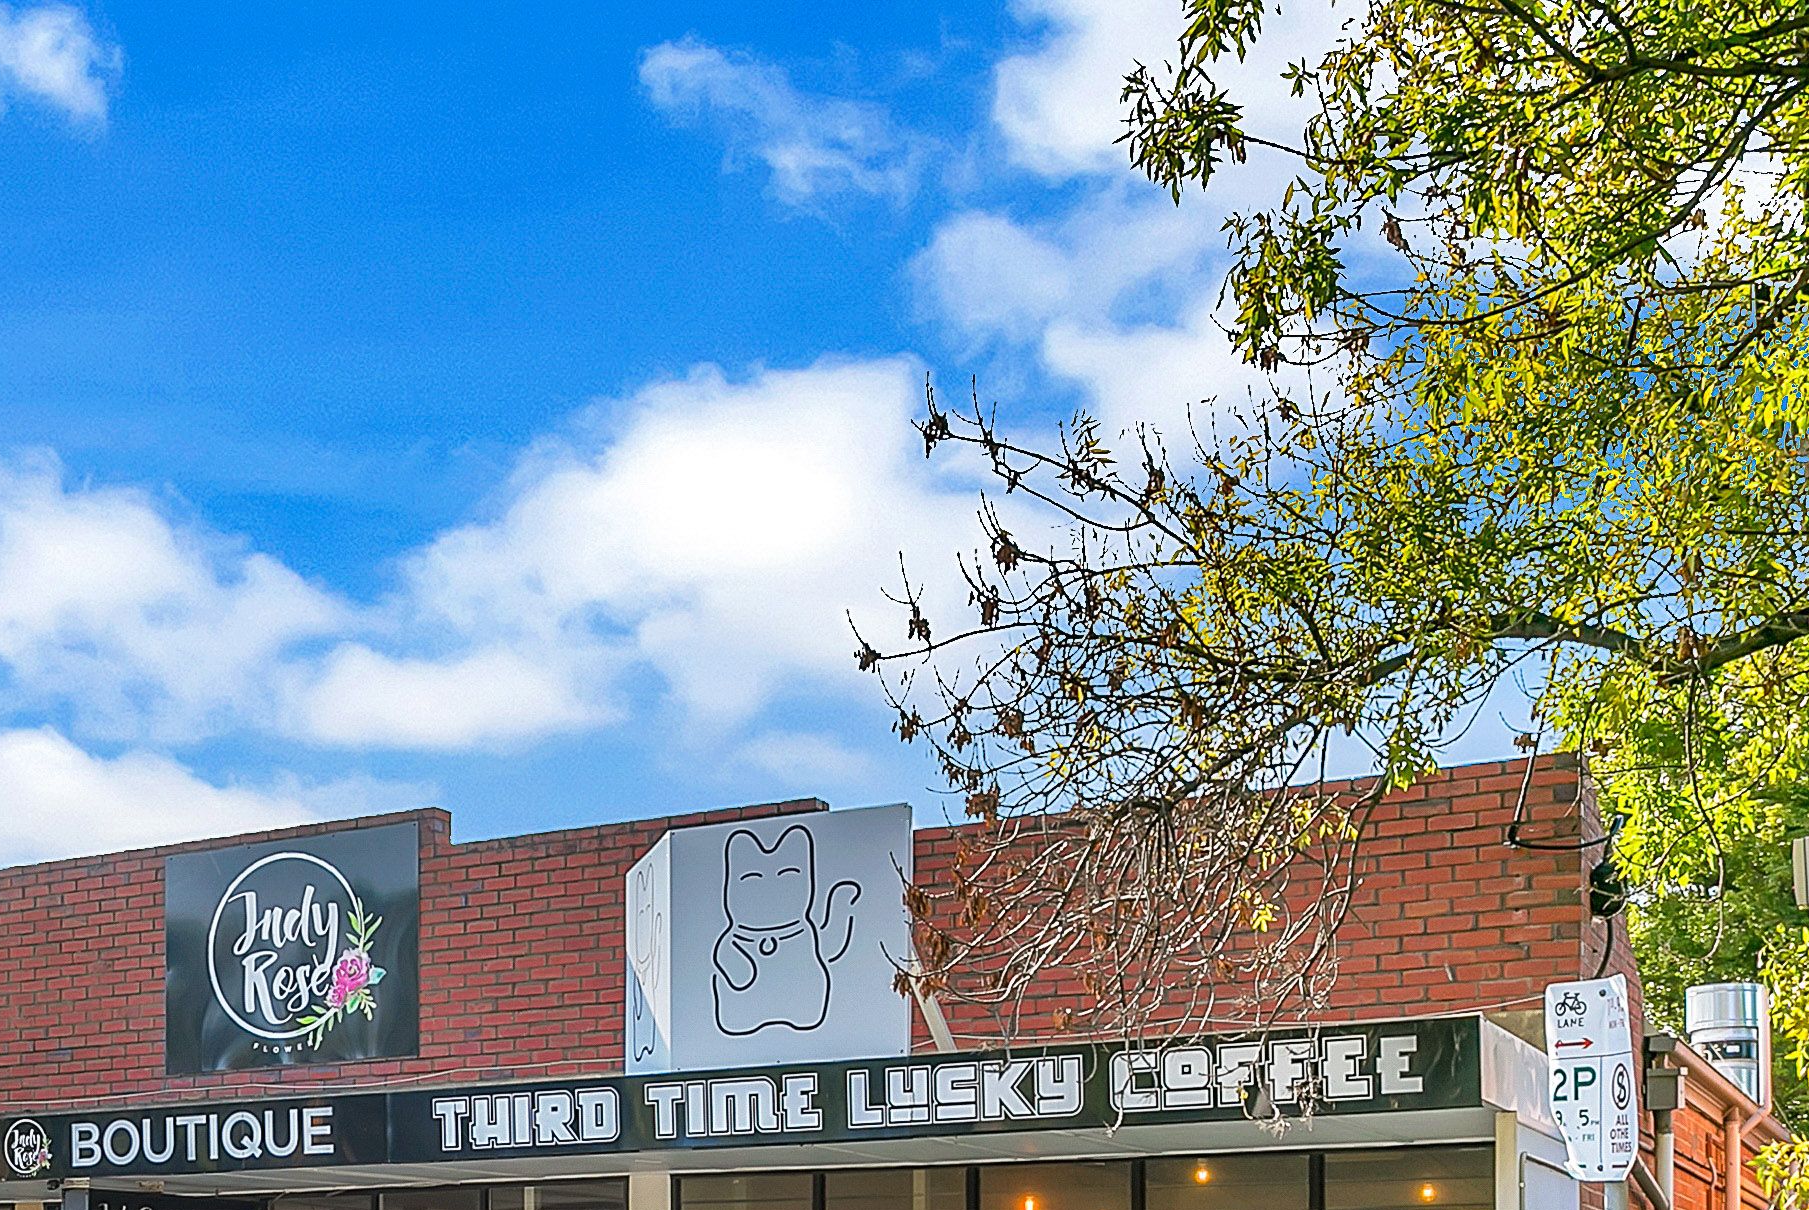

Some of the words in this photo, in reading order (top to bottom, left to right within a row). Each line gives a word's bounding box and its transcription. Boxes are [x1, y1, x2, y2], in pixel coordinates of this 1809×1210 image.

[228, 884, 339, 971] Indy
[242, 950, 330, 1025] Rose
[1557, 1017, 1584, 1029] LANE
[432, 1086, 621, 1151] THIRD
[644, 1072, 823, 1141] TIME
[847, 1054, 1084, 1129] LUCKY
[1109, 1035, 1423, 1112] COFFEE
[1553, 1066, 1596, 1101] 2P
[1610, 1127, 1629, 1140] OTHE
[1615, 1114, 1628, 1126] ALL
[11, 1128, 41, 1154] Indy
[71, 1106, 334, 1168] BOUTIQUE
[1611, 1141, 1632, 1153] TIMES
